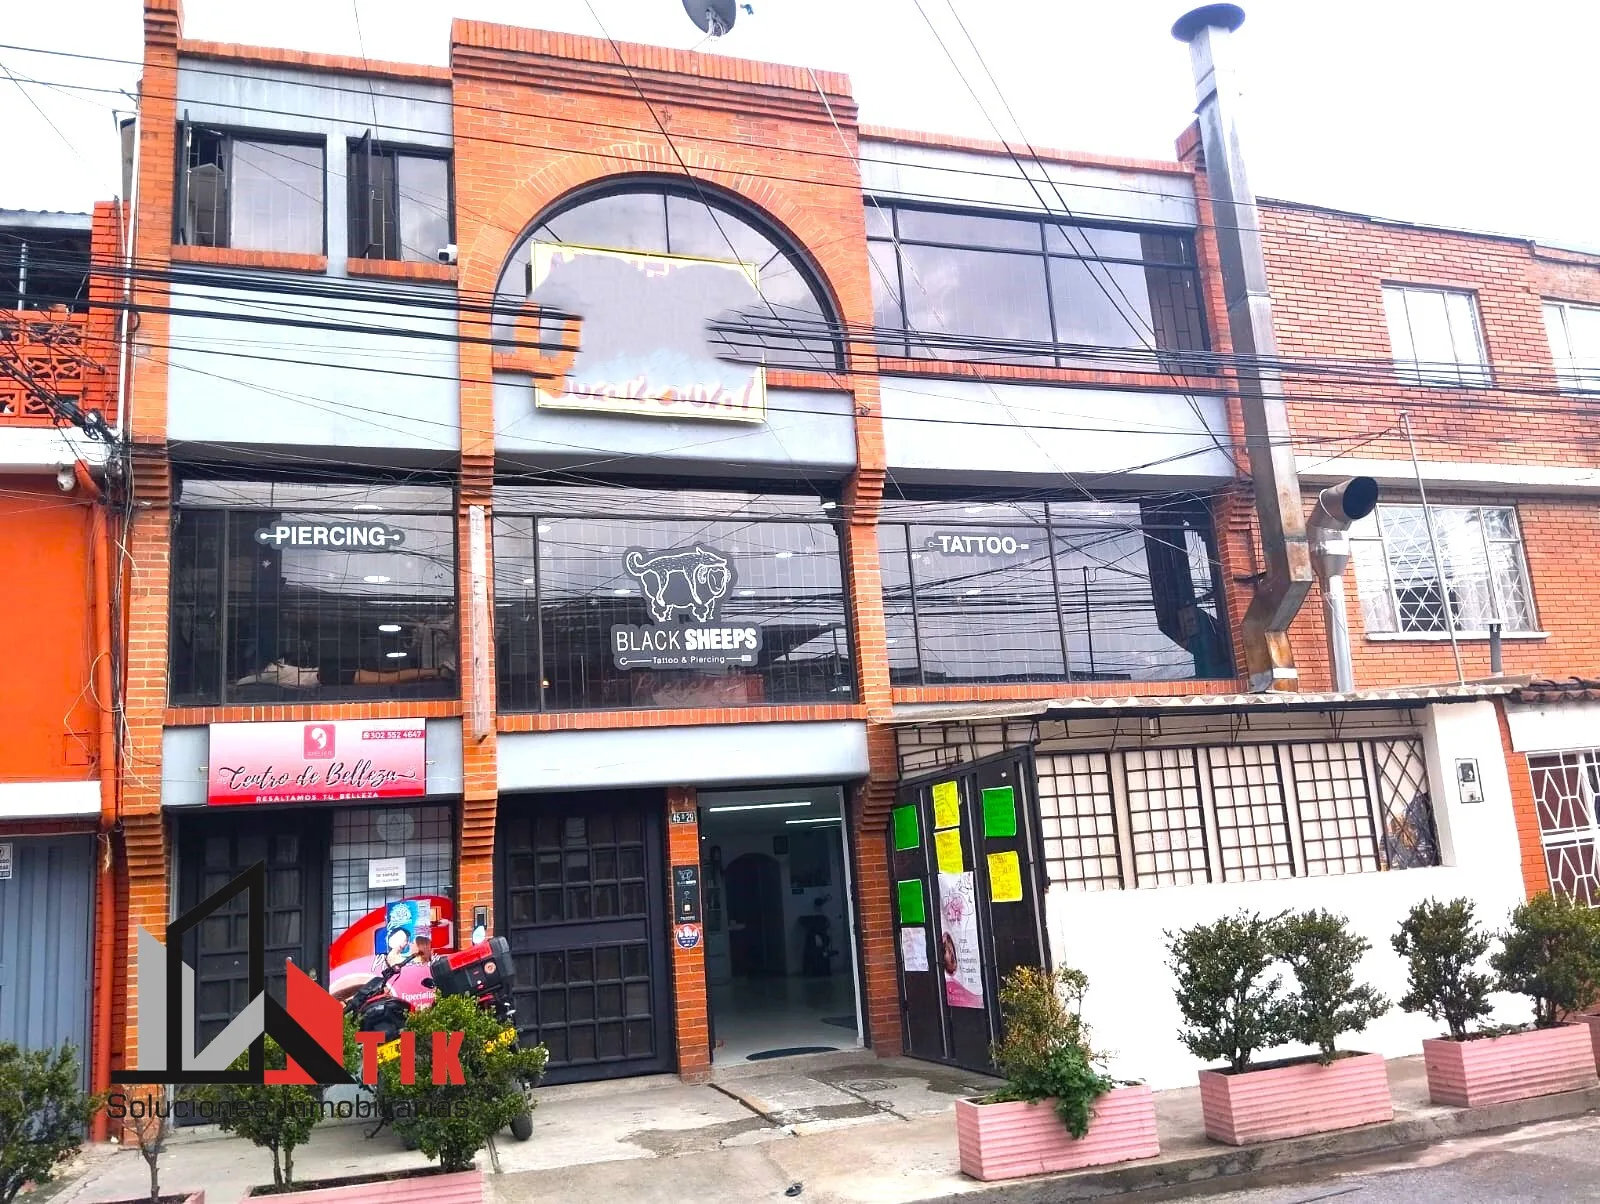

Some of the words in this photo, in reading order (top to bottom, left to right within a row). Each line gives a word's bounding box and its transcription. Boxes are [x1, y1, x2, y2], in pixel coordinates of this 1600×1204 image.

[275, 526, 386, 546] PIERCING
[938, 535, 1017, 554] TATTOO
[616, 630, 681, 652] BLACK
[684, 627, 758, 650] SHEEPS
[653, 656, 679, 665] Tattoo
[681, 656, 688, 664] &
[690, 655, 725, 665] Piercing
[387, 731, 401, 739] 552
[219, 765, 289, 790] Centro
[296, 765, 319, 788] de
[325, 758, 415, 789] Belleza
[256, 794, 317, 803] RESALTAMOS
[339, 791, 379, 800] BELLEZA
